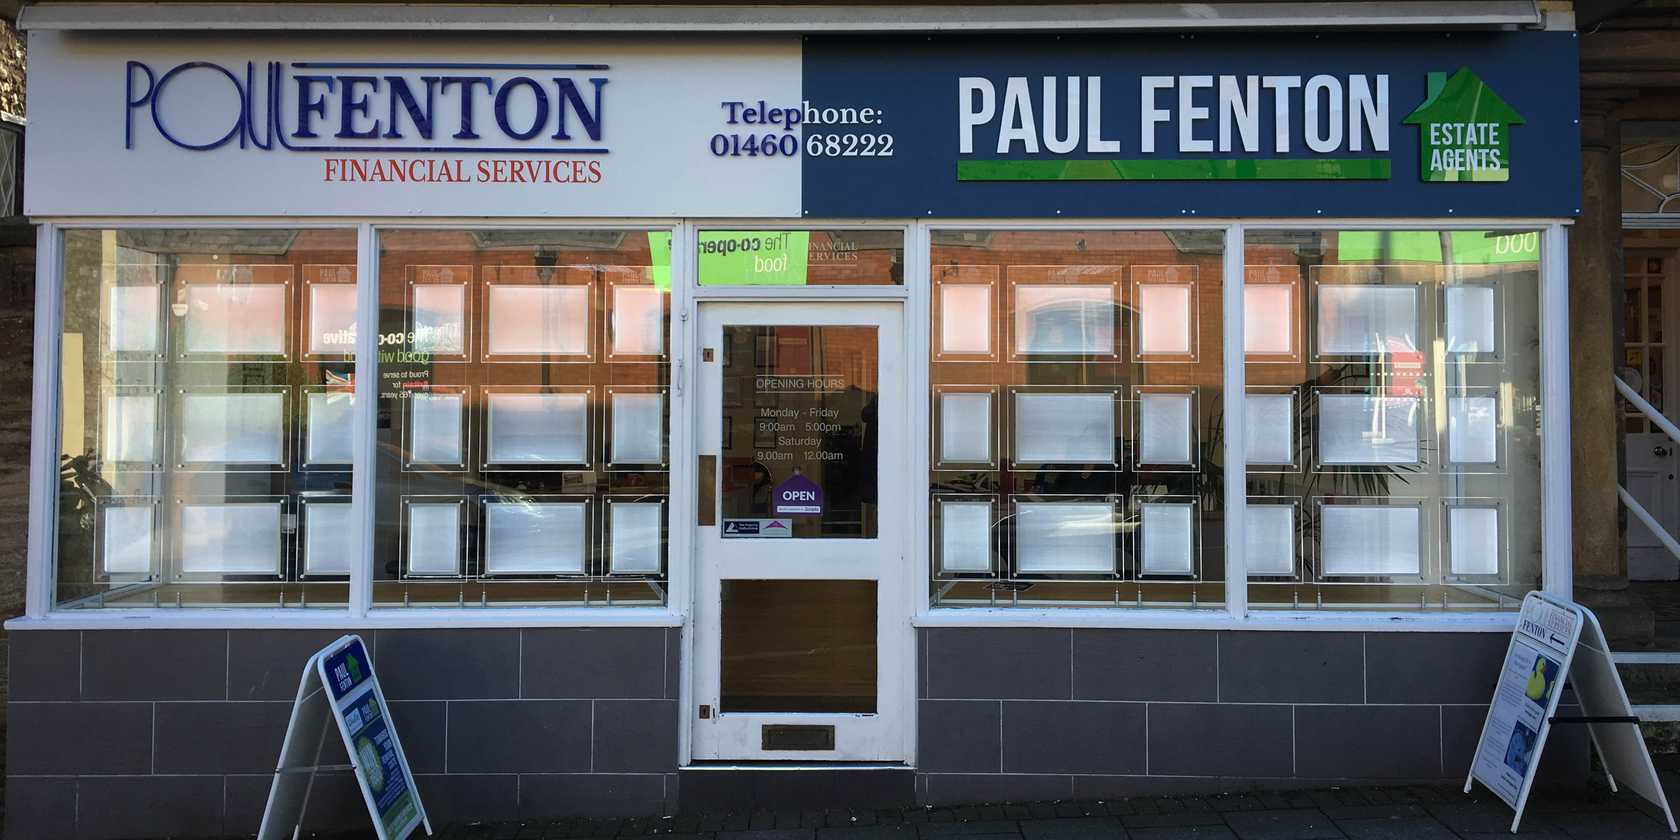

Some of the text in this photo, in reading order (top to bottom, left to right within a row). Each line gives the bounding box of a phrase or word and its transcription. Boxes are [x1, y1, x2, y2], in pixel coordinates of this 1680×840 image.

[291, 75, 609, 141] FENTON
[721, 100, 883, 131] Telephone:
[958, 74, 1390, 154] PAUL FENTON
[1430, 122, 1500, 145] ESTATE
[710, 134, 894, 157] 01460 68222
[323, 158, 602, 184] FINANCIAL SERVICES
[1430, 148, 1501, 172] AGENTS
[808, 240, 858, 251] INANCIAL
[808, 251, 858, 261] ERVICES
[756, 379, 845, 389] OPENING HOURS
[760, 408, 800, 419] Monday
[809, 408, 840, 418] Friday
[778, 436, 822, 448] Saturday
[782, 490, 815, 501] OPEN
